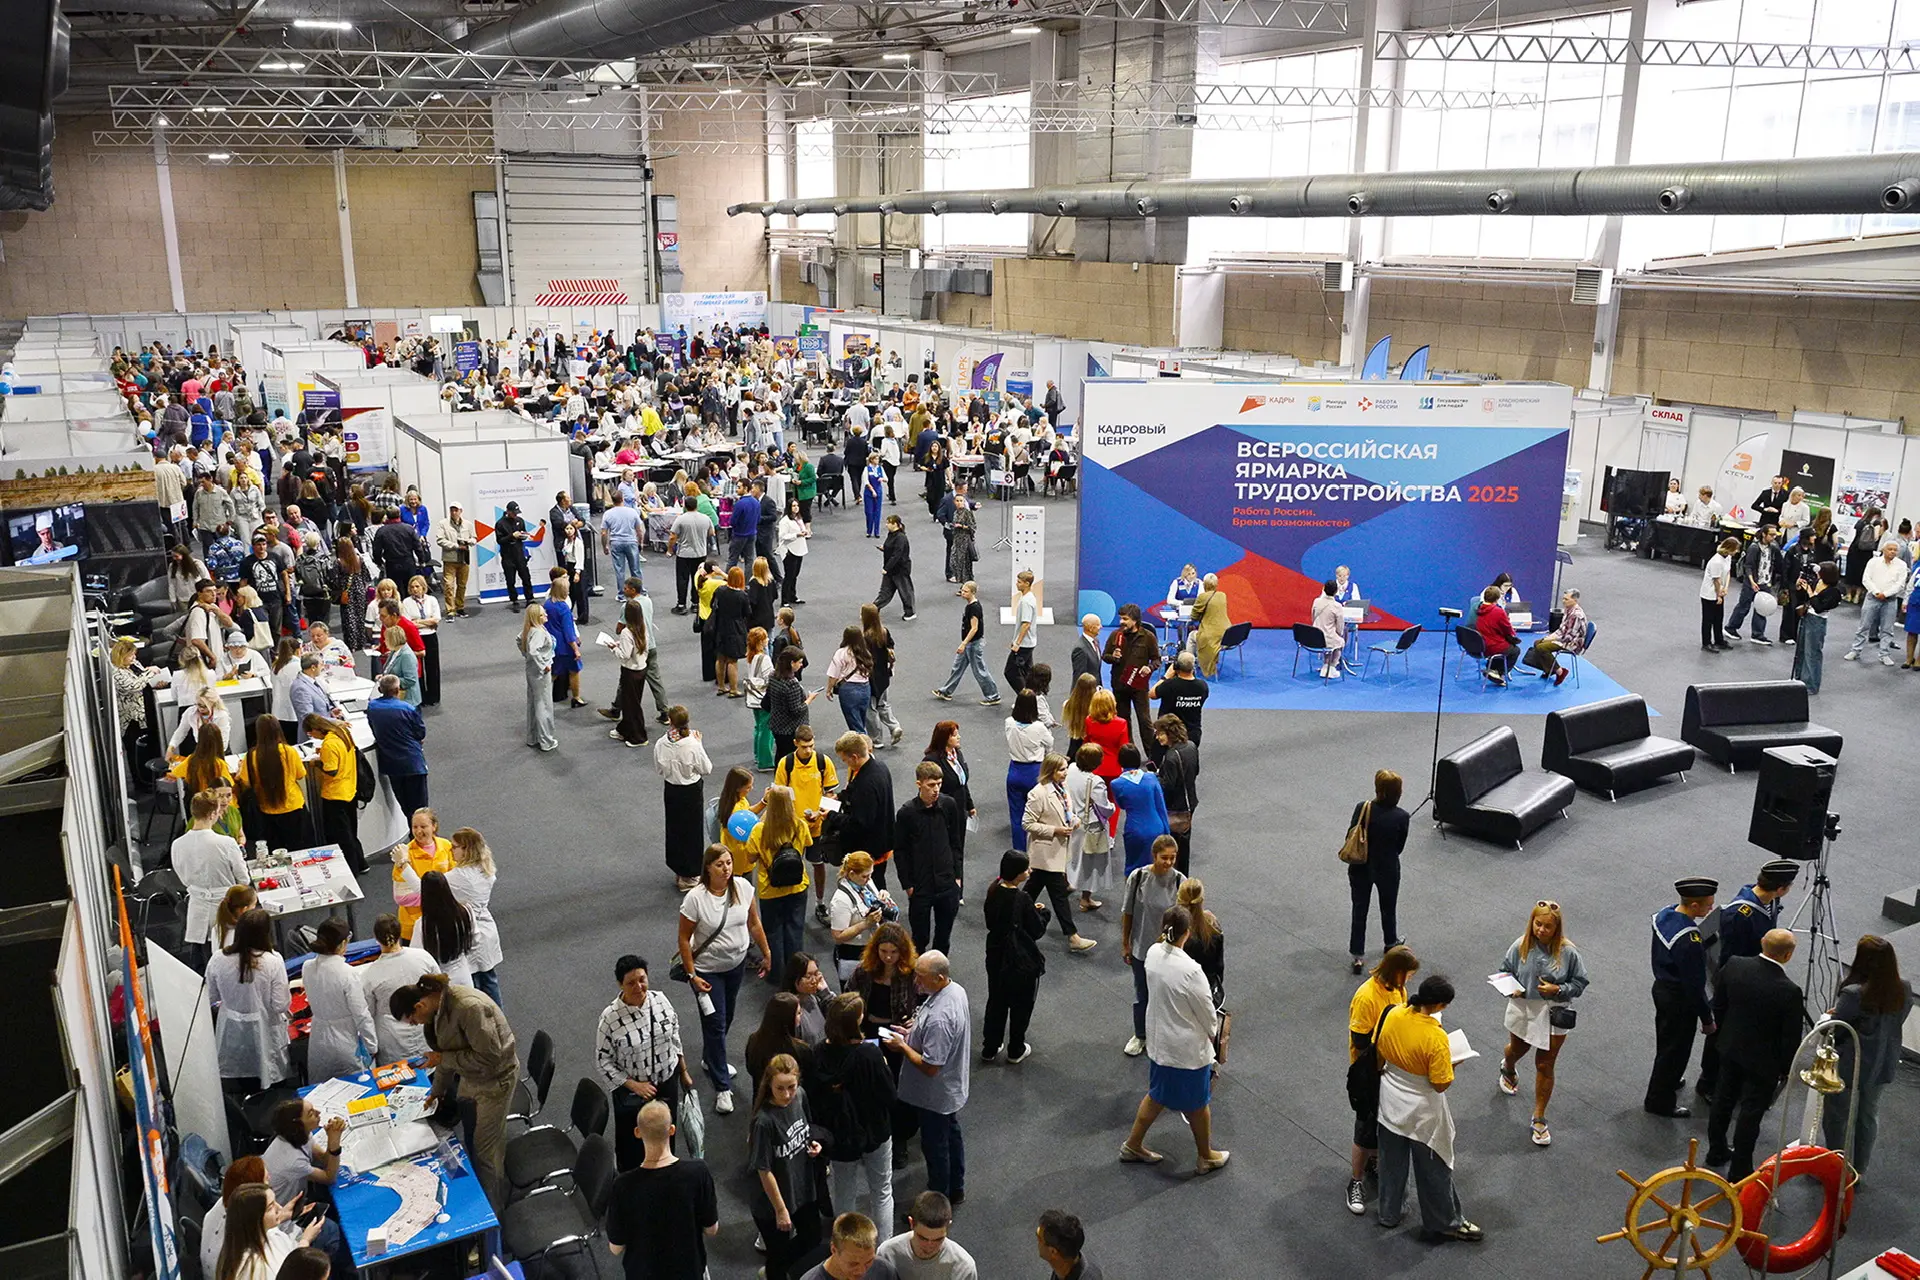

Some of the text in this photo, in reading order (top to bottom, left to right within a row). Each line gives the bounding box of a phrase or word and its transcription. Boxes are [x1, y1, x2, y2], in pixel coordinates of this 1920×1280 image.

[1652, 410, 1683, 422] СКЛАД
[1098, 424, 1166, 435] КАДРОВЫЙ
[1098, 436, 1137, 446] ЦЕНТР
[1237, 439, 1438, 460] ВСЕРОССИЙСКАЯ
[1235, 462, 1347, 479] ЯРМАРКА
[1234, 481, 1519, 503] ТРУДОУСТРОЙСТВА 2025
[1233, 507, 1316, 516] Работа России.
[1232, 518, 1350, 527] Время возможностей
